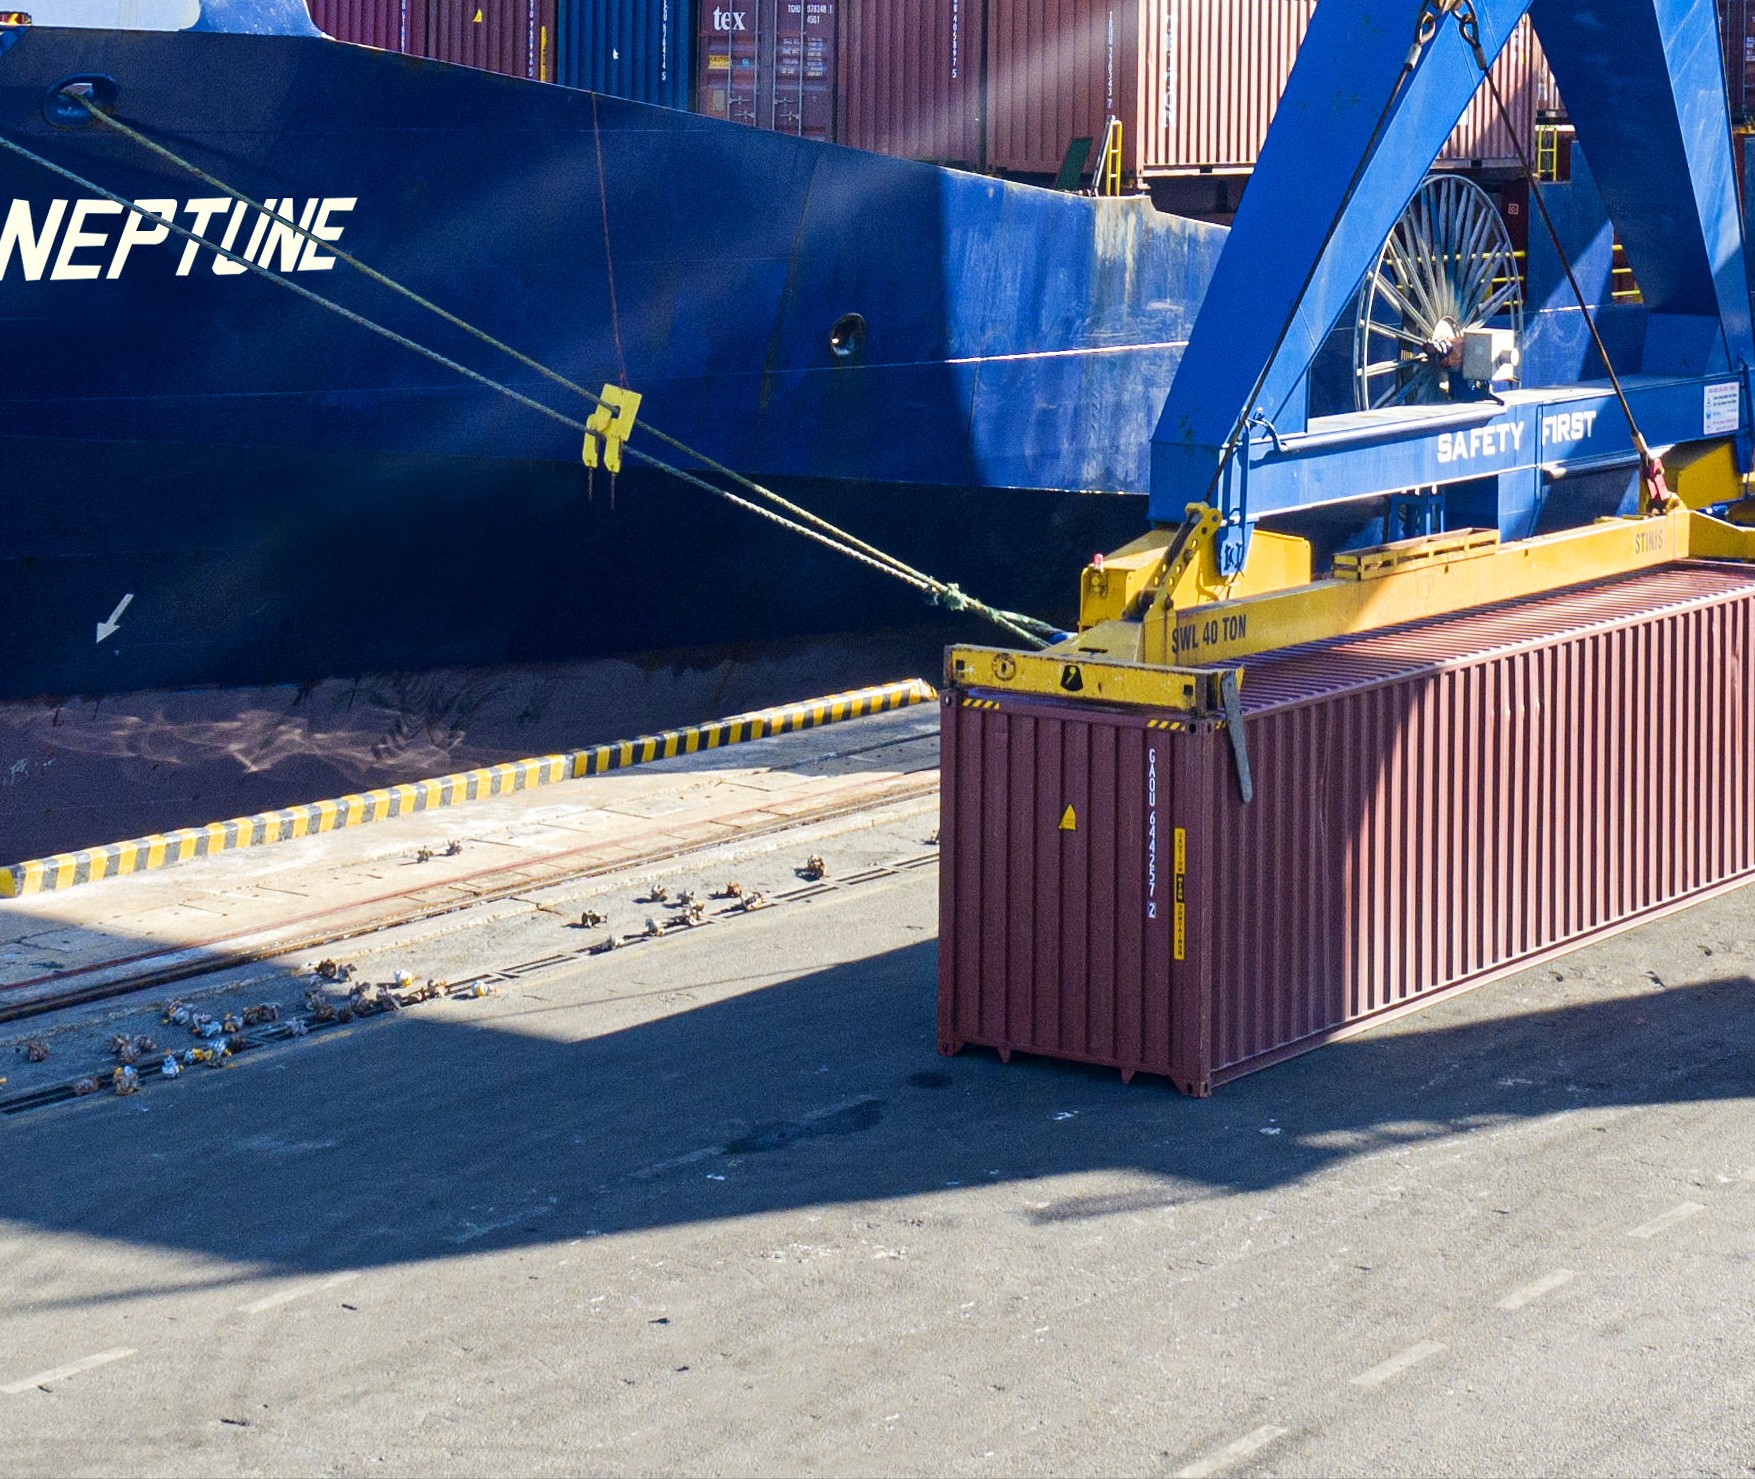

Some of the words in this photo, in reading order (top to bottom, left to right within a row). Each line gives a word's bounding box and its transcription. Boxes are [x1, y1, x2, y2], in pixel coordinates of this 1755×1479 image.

[712, 5, 746, 31] tex
[951, 68, 957, 78] 5
[1437, 420, 1525, 464] SAFETY
[1541, 410, 1597, 447] FIRST
[1634, 532, 1664, 555] STINIS
[1171, 624, 1198, 653] SWL
[1202, 620, 1219, 644] 40
[1221, 614, 1247, 641] TON
[1148, 747, 1156, 807] GAOU
[1148, 810, 1156, 898] 644257
[1147, 901, 1157, 919] 2
